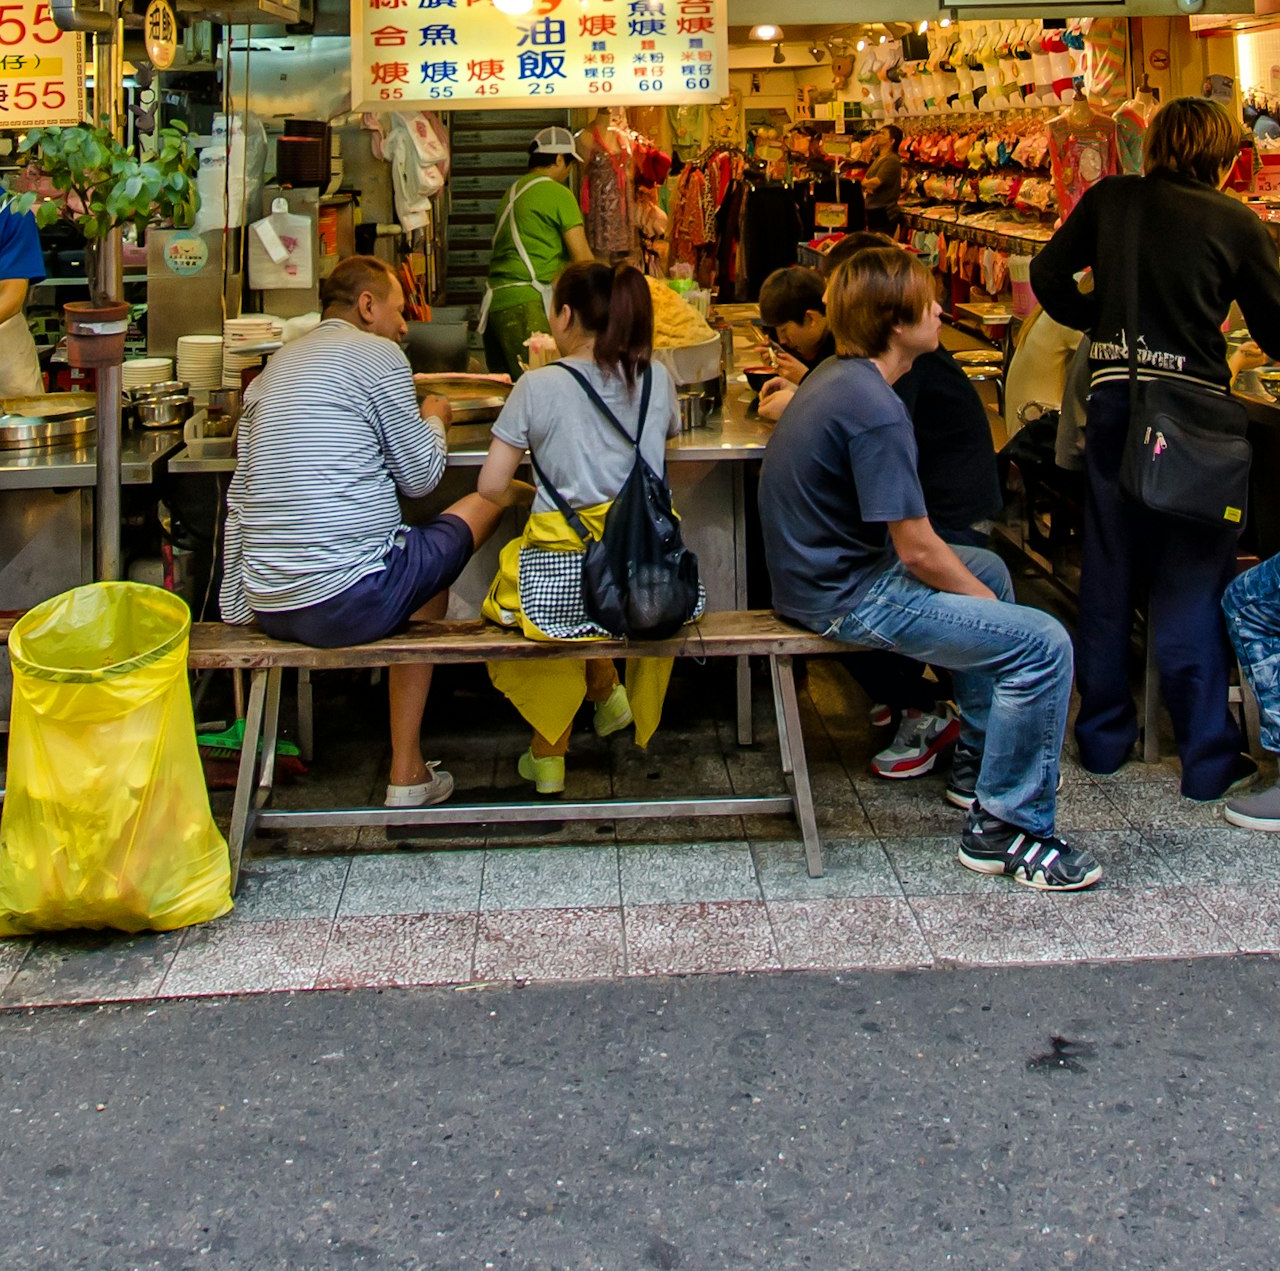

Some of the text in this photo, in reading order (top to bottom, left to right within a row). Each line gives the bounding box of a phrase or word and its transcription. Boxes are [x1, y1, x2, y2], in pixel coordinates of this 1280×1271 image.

[516, 17, 567, 79] 油飯
[474, 83, 499, 95] 45
[528, 83, 555, 95] 25
[589, 81, 612, 93] 50
[640, 79, 663, 91] 60
[686, 77, 710, 89] 60
[380, 88, 403, 100] 55
[430, 86, 454, 98] 55
